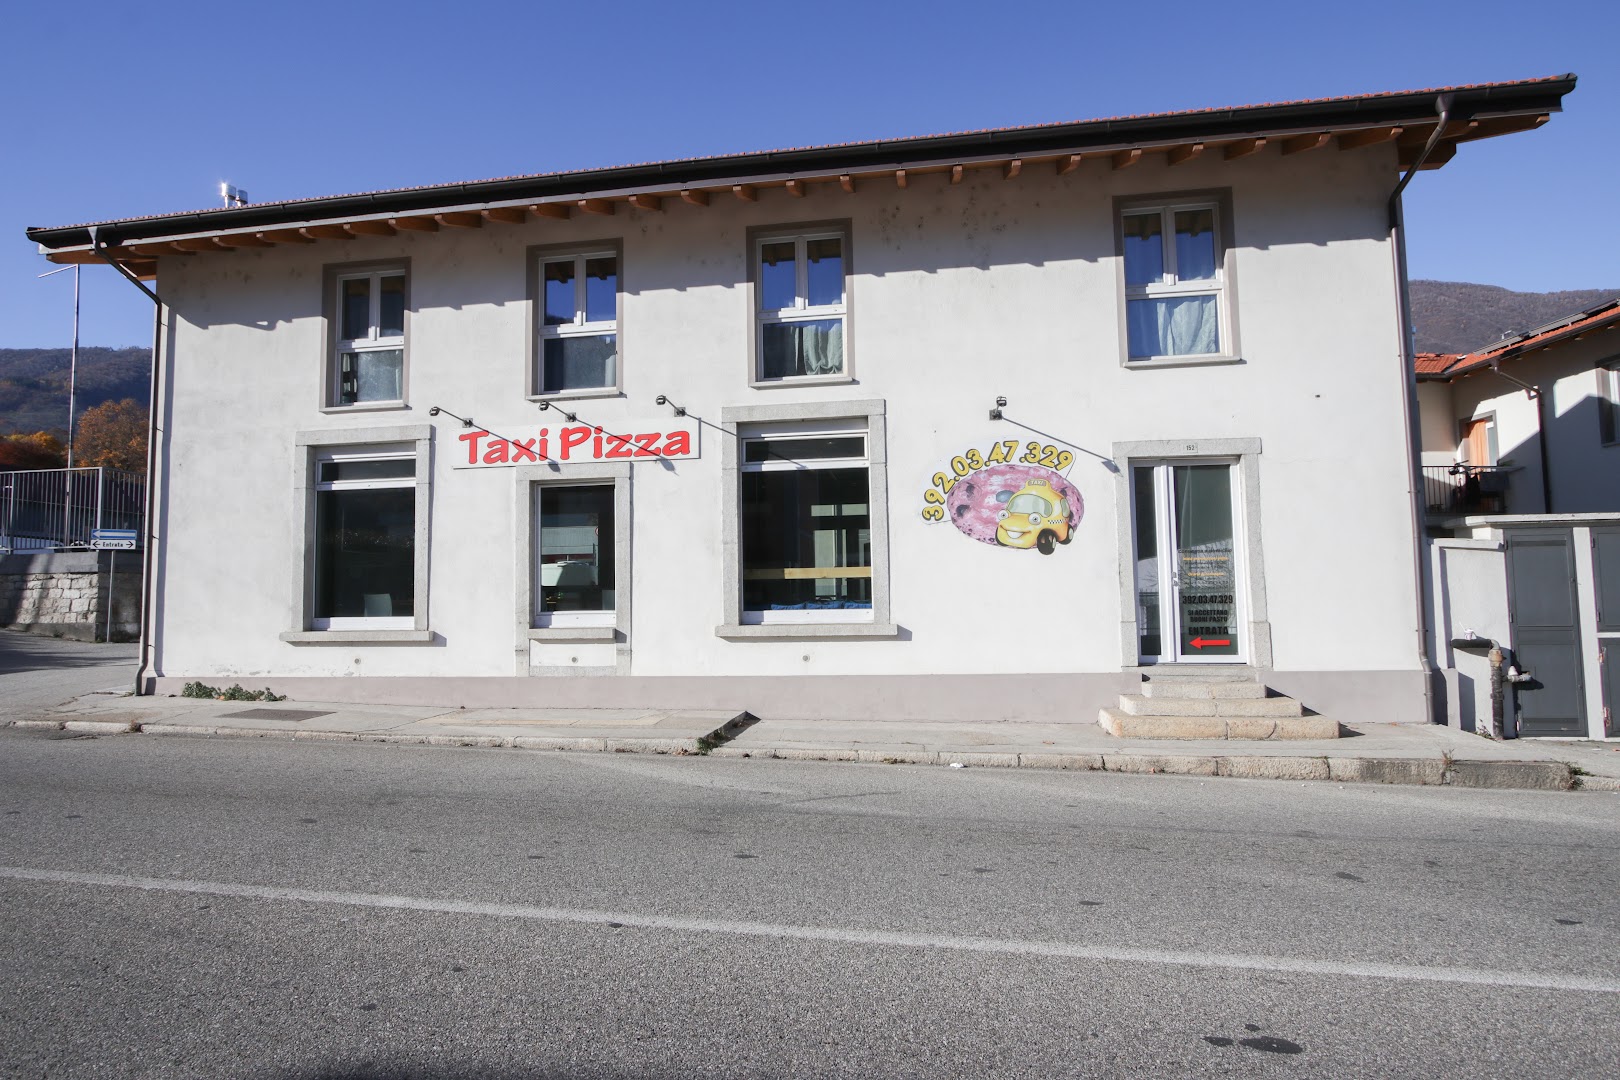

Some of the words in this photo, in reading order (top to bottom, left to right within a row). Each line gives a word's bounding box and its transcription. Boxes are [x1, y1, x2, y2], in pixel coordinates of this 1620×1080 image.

[458, 427, 549, 465] Taxi
[559, 425, 691, 460] Pizza
[922, 440, 1074, 521] 392.03.47.329
[1188, 626, 1229, 636] ENTRATA
